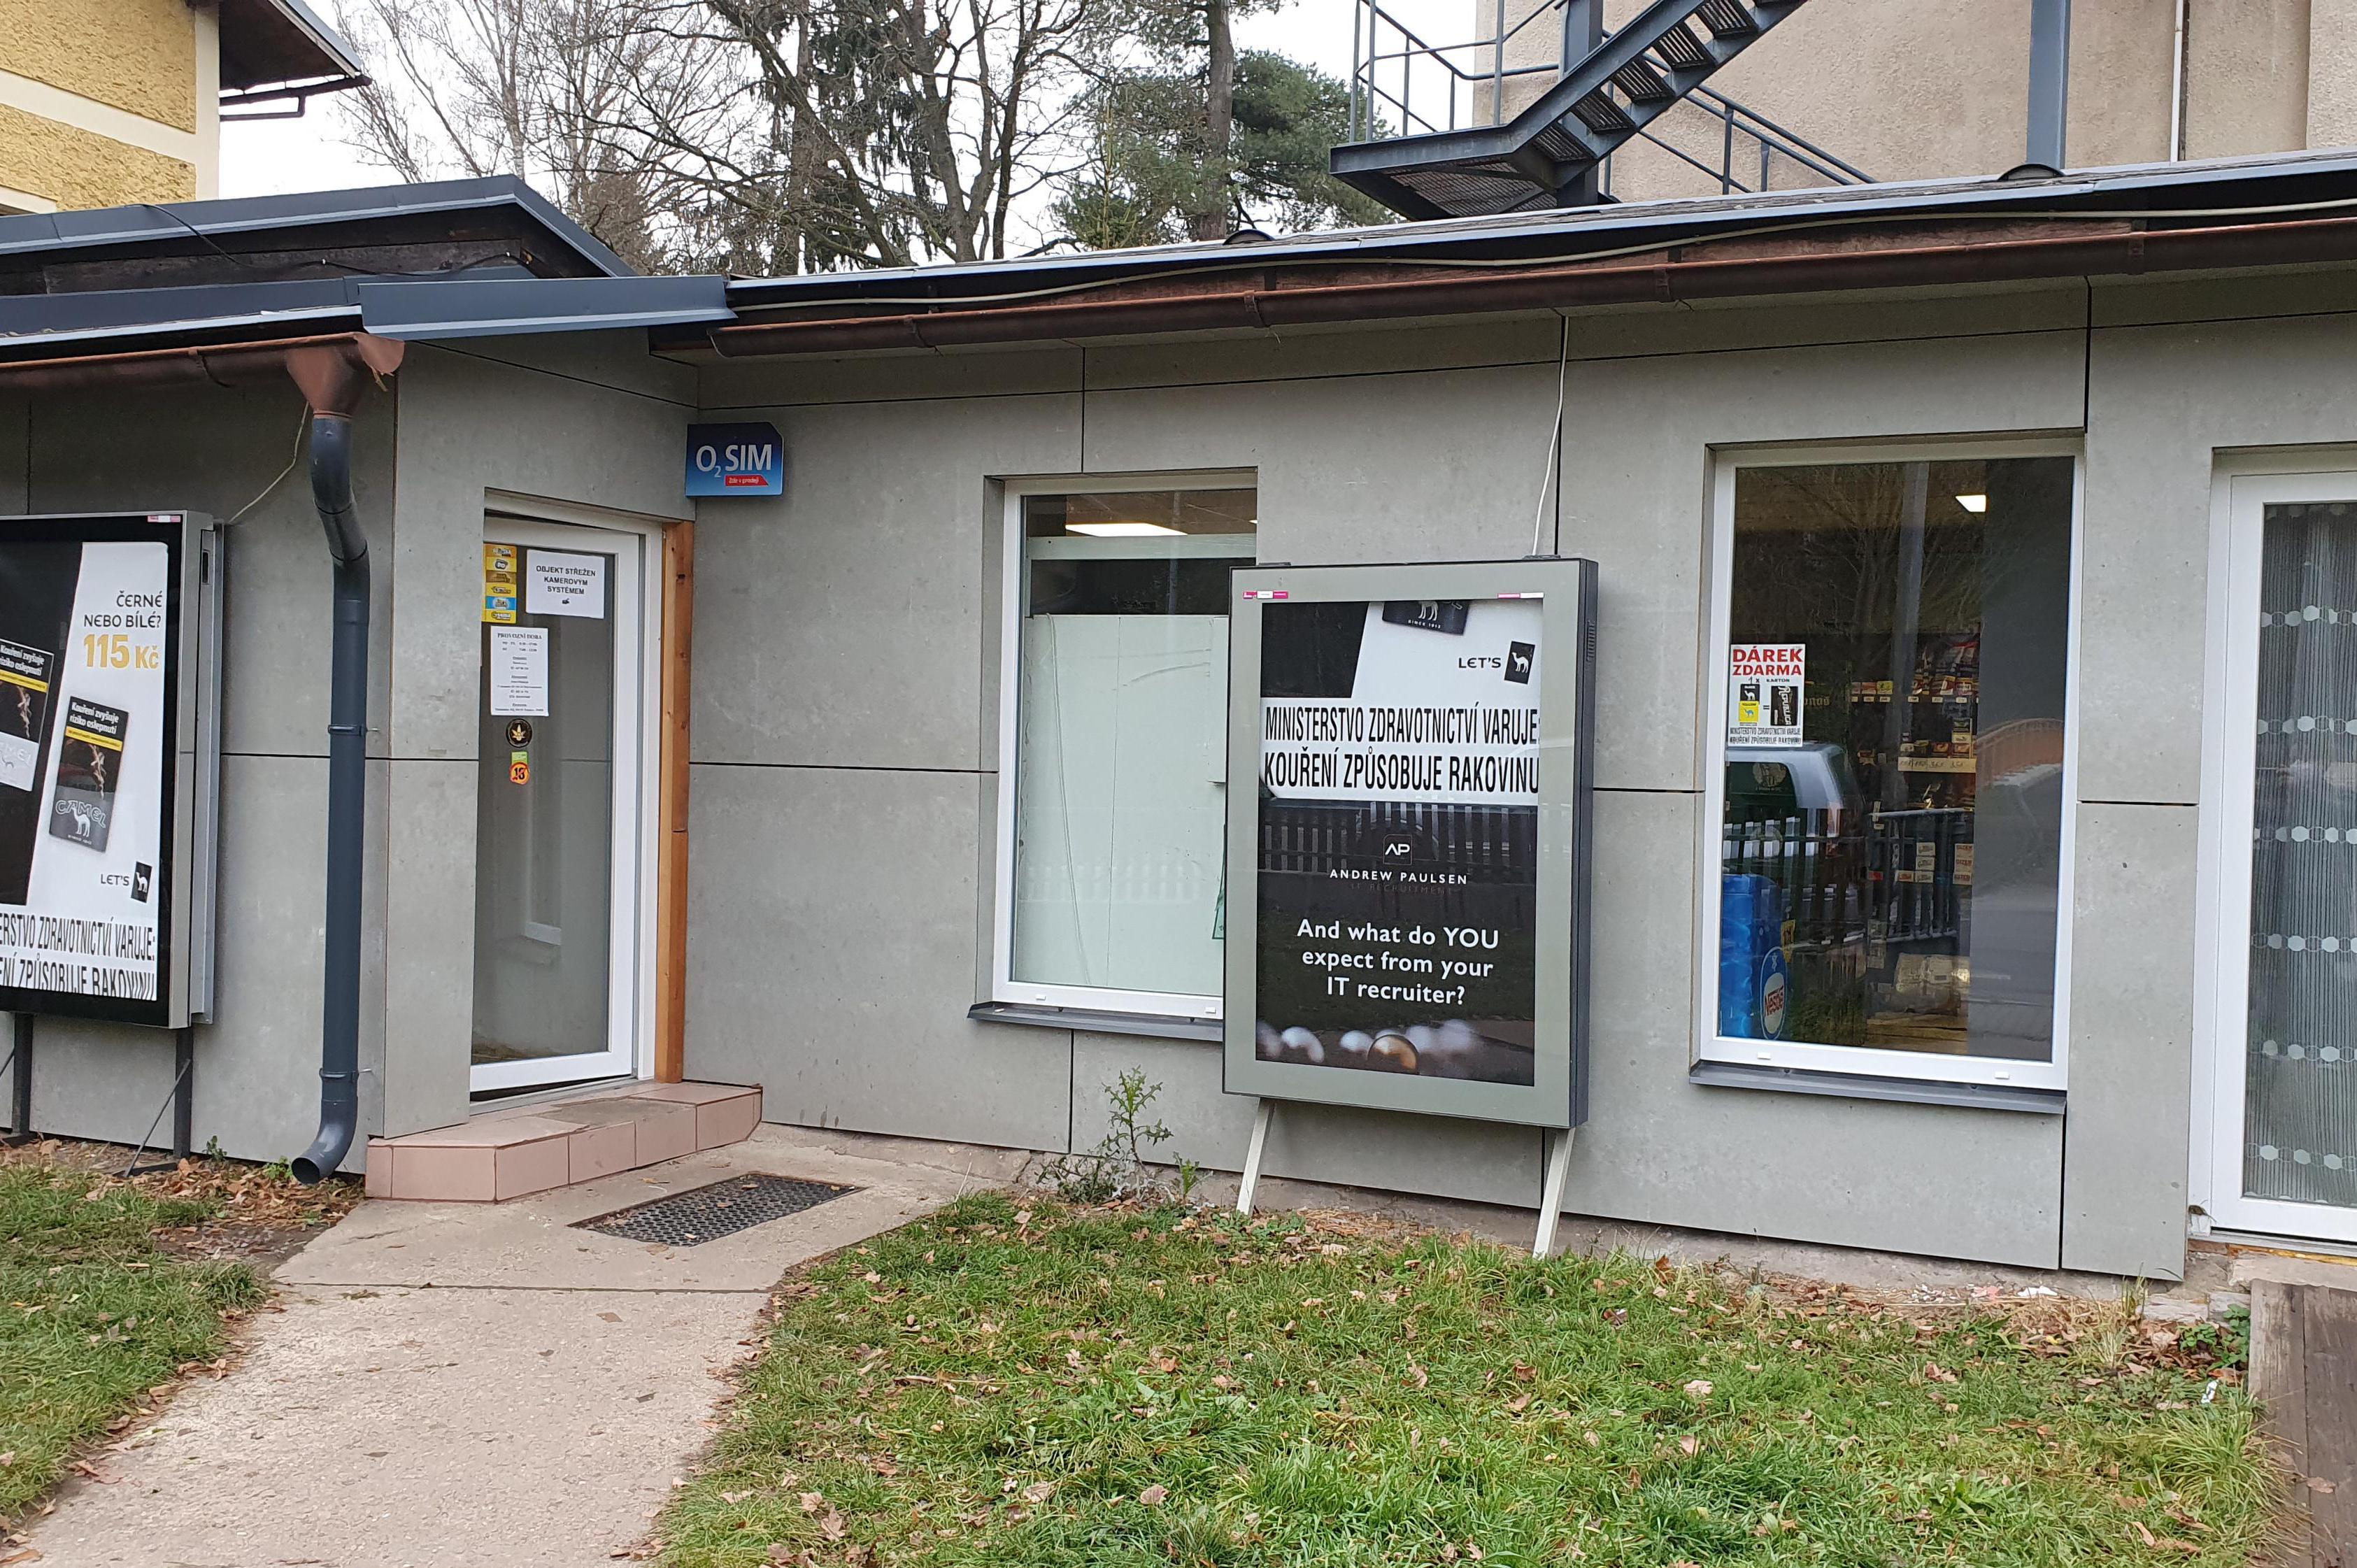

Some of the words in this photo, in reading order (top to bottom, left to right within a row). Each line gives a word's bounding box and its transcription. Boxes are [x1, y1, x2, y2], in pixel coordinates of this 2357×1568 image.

[725, 444, 772, 472] SIM
[536, 565, 564, 574] OBJEKT
[565, 567, 596, 577] STŘEŽEN
[116, 590, 163, 608] ČERNÉ
[547, 585, 585, 594] SYSTÉMEM
[84, 614, 122, 628] NEBO
[126, 611, 162, 629] BÍLÉ?
[83, 634, 130, 669] 115
[135, 644, 159, 669] Kč
[1458, 657, 1502, 669] LET'S
[1732, 646, 1803, 662] DÁREK
[1732, 664, 1802, 676] ZDARMA
[1265, 706, 1364, 743] MINISTERSTVO
[1368, 701, 1480, 744] ZDRAVOTNICTVÍ
[1264, 746, 1339, 788] KOUŘENÍ
[1344, 746, 1443, 791] ZPŮSOBUJE
[1449, 755, 1539, 794] RAKOVINU
[55, 799, 107, 829] CAMEL
[100, 874, 130, 887] LET'S
[1330, 869, 1393, 881] ANDREW
[1400, 872, 1467, 885] PAULSEN
[37, 915, 114, 957] ZDRAVOTNICTVÍ
[115, 922, 155, 962] VARUJE:
[1297, 918, 1340, 940] And
[1348, 921, 1401, 944] what
[1409, 925, 1436, 946] do
[1443, 927, 1500, 950] YOU
[1302, 950, 1374, 972] expect
[1381, 951, 1433, 974] from
[1441, 959, 1494, 980] your
[1327, 976, 1350, 996] IT
[1357, 983, 1465, 1006] recruiter?
